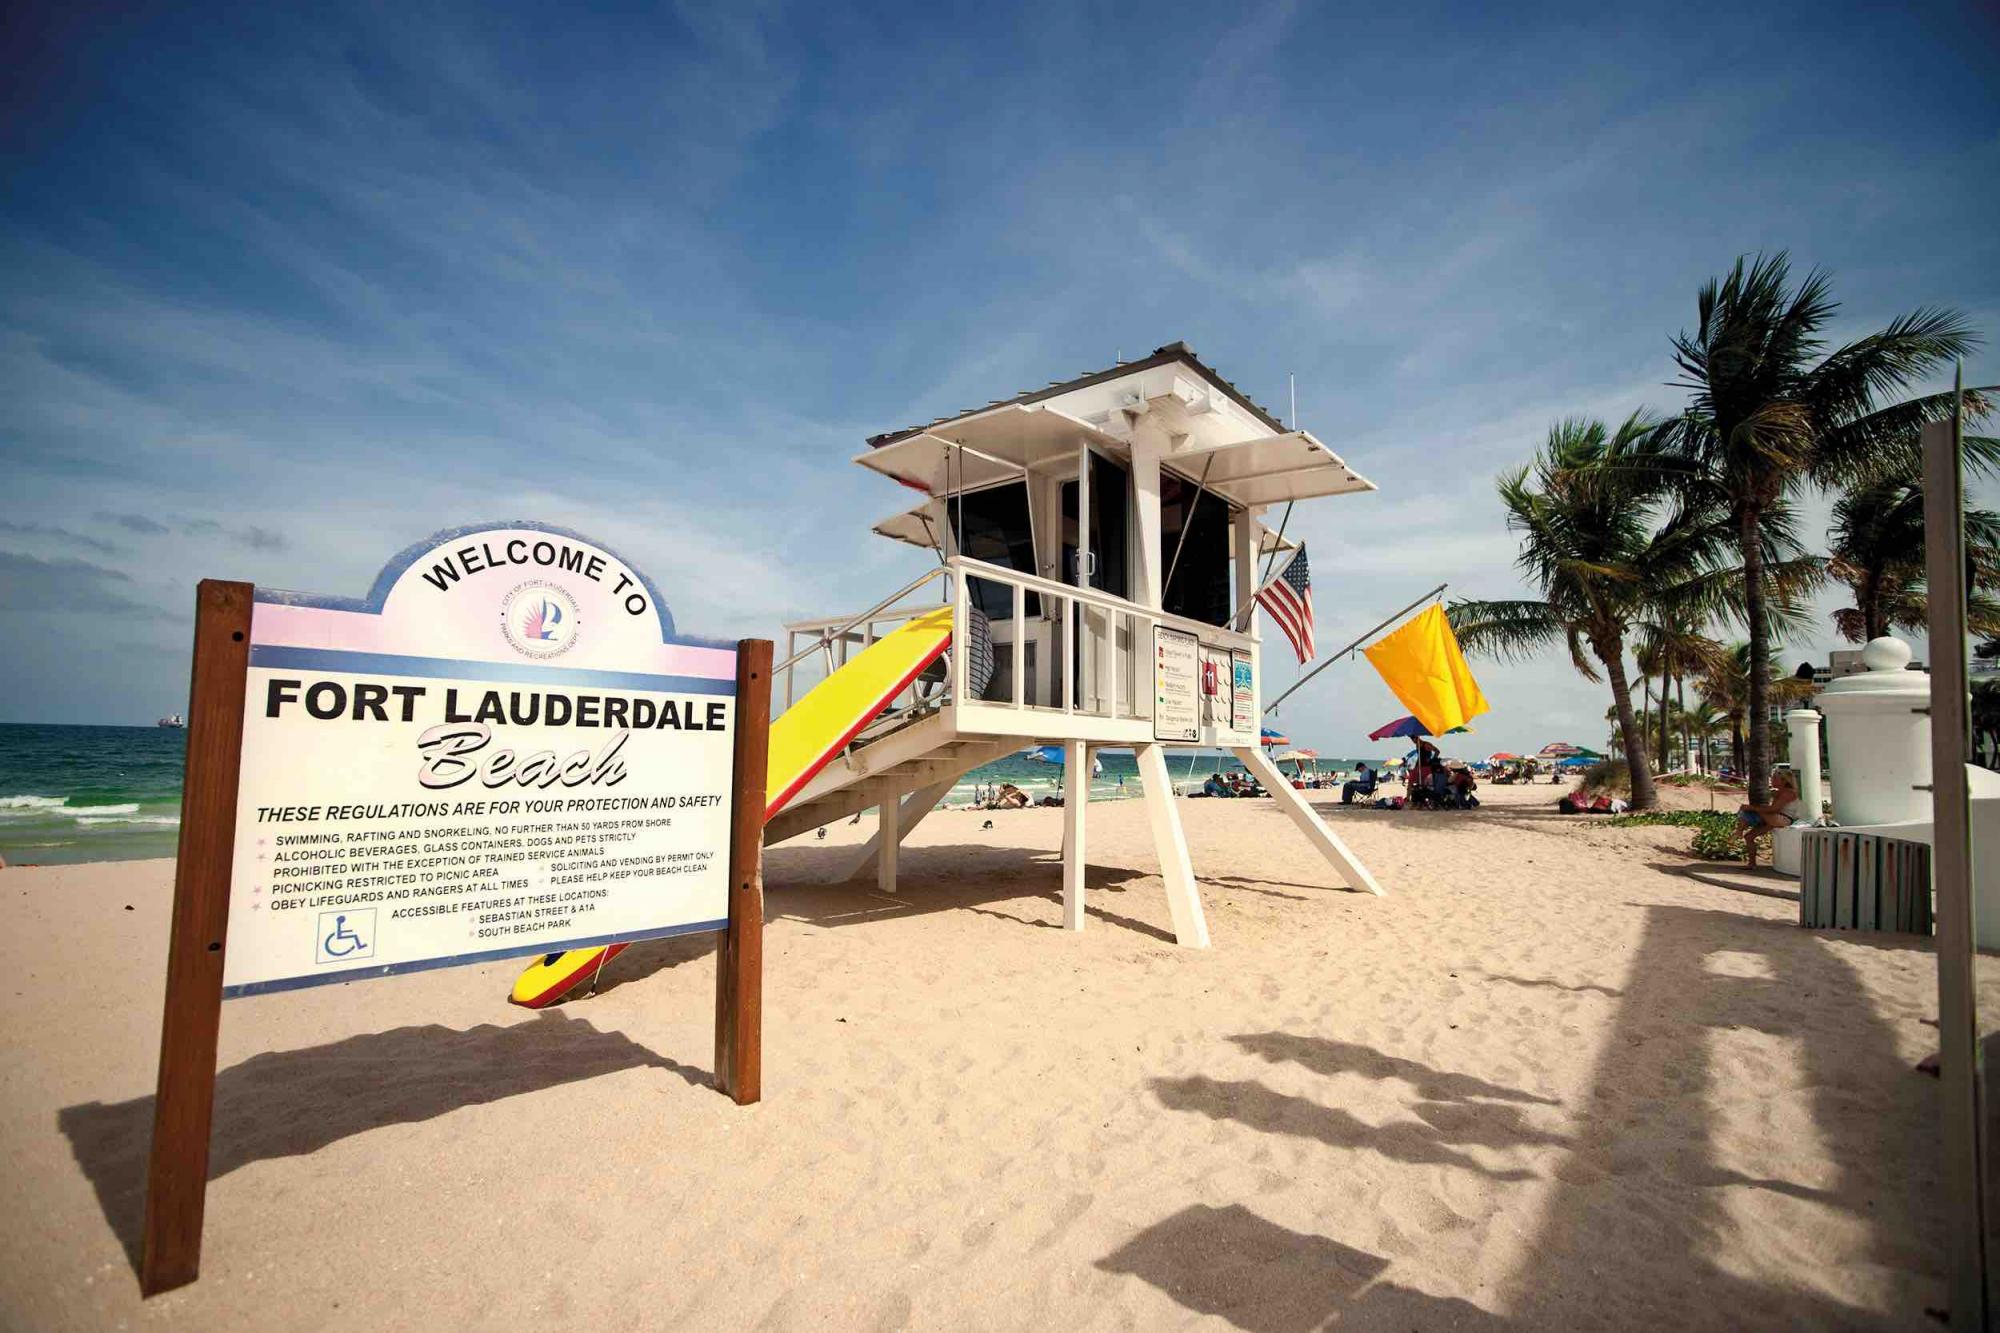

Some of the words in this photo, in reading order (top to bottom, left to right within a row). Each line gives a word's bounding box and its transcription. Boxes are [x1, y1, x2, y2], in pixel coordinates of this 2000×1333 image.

[422, 539, 607, 592] WELCOME
[612, 573, 647, 616] TO
[513, 583, 522, 593] OF
[524, 579, 543, 587] FORT
[544, 581, 581, 612] LAUDERDALE
[511, 643, 525, 655] AND
[265, 678, 426, 722] FORT
[444, 688, 726, 731] LAUDERDALE
[416, 721, 630, 790] Beach
[257, 806, 322, 823] THESE
[325, 802, 449, 821] REGULATIONS
[452, 801, 486, 816] ARE
[489, 800, 520, 815] FOR
[525, 799, 564, 814] YOUR
[566, 797, 648, 812] PROTECTION
[650, 796, 676, 809] AND
[678, 795, 722, 808] SAFETY
[346, 831, 396, 842] RAFTING
[398, 830, 421, 840] AND
[495, 826, 509, 835] NO
[511, 824, 553, 834] FURTHER
[556, 823, 579, 831] THAN
[581, 822, 590, 830] 50
[593, 821, 619, 829] YARDS
[621, 820, 644, 828] FROM
[645, 818, 671, 827] SHORE
[274, 848, 346, 862] ALCOHOLIC
[423, 842, 458, 853] GLASS
[527, 837, 553, 847] DOGS
[554, 836, 573, 845] AND
[575, 834, 597, 844] PETS
[599, 833, 636, 842] STRICTLY
[551, 860, 598, 872] SOLICITING
[600, 859, 618, 868] AND
[619, 856, 654, 866] VENDING
[655, 855, 666, 863] BY
[667, 853, 694, 862] PERMIT
[696, 851, 714, 860] ONLY
[273, 864, 348, 878] PROHIBITED
[351, 862, 379, 873] WITH
[383, 860, 404, 870] THE
[407, 856, 466, 869] EXCEPTION
[468, 855, 481, 864] OF
[484, 852, 525, 863] TRAINED
[528, 849, 565, 860] SERVICE
[567, 847, 604, 857] ANIMALS
[551, 874, 584, 885] PLEASE
[586, 872, 608, 882] HELP
[610, 870, 631, 879] KEEP
[633, 868, 655, 877] YOUR
[656, 866, 682, 876] BEACH
[683, 864, 707, 873] CLEAN
[271, 898, 306, 911] OBEY
[309, 891, 384, 907] LIFEGUARDS
[386, 889, 410, 900] AND
[413, 884, 463, 897] RANGERS
[465, 883, 478, 893] AT
[480, 882, 498, 891] ALL
[501, 879, 528, 890] TIMES
[272, 879, 343, 895] PICNICKING
[346, 874, 416, 888] RESTRICTED
[419, 872, 434, 882] TO
[436, 870, 470, 881] PICNIC
[472, 868, 499, 878] AREA
[391, 903, 458, 919] ACCESSIBLE
[461, 898, 512, 911] FEATURES
[513, 897, 525, 906] AT
[528, 894, 556, 904] THESE
[559, 889, 609, 902] LOCATIONS:
[479, 910, 532, 924] SEBASTIAN
[534, 906, 568, 918] STREET
[571, 905, 576, 914] &
[578, 903, 595, 912] A1A
[478, 926, 511, 938] SOUTH
[513, 922, 545, 934] BEACH
[547, 919, 571, 929] PARK
